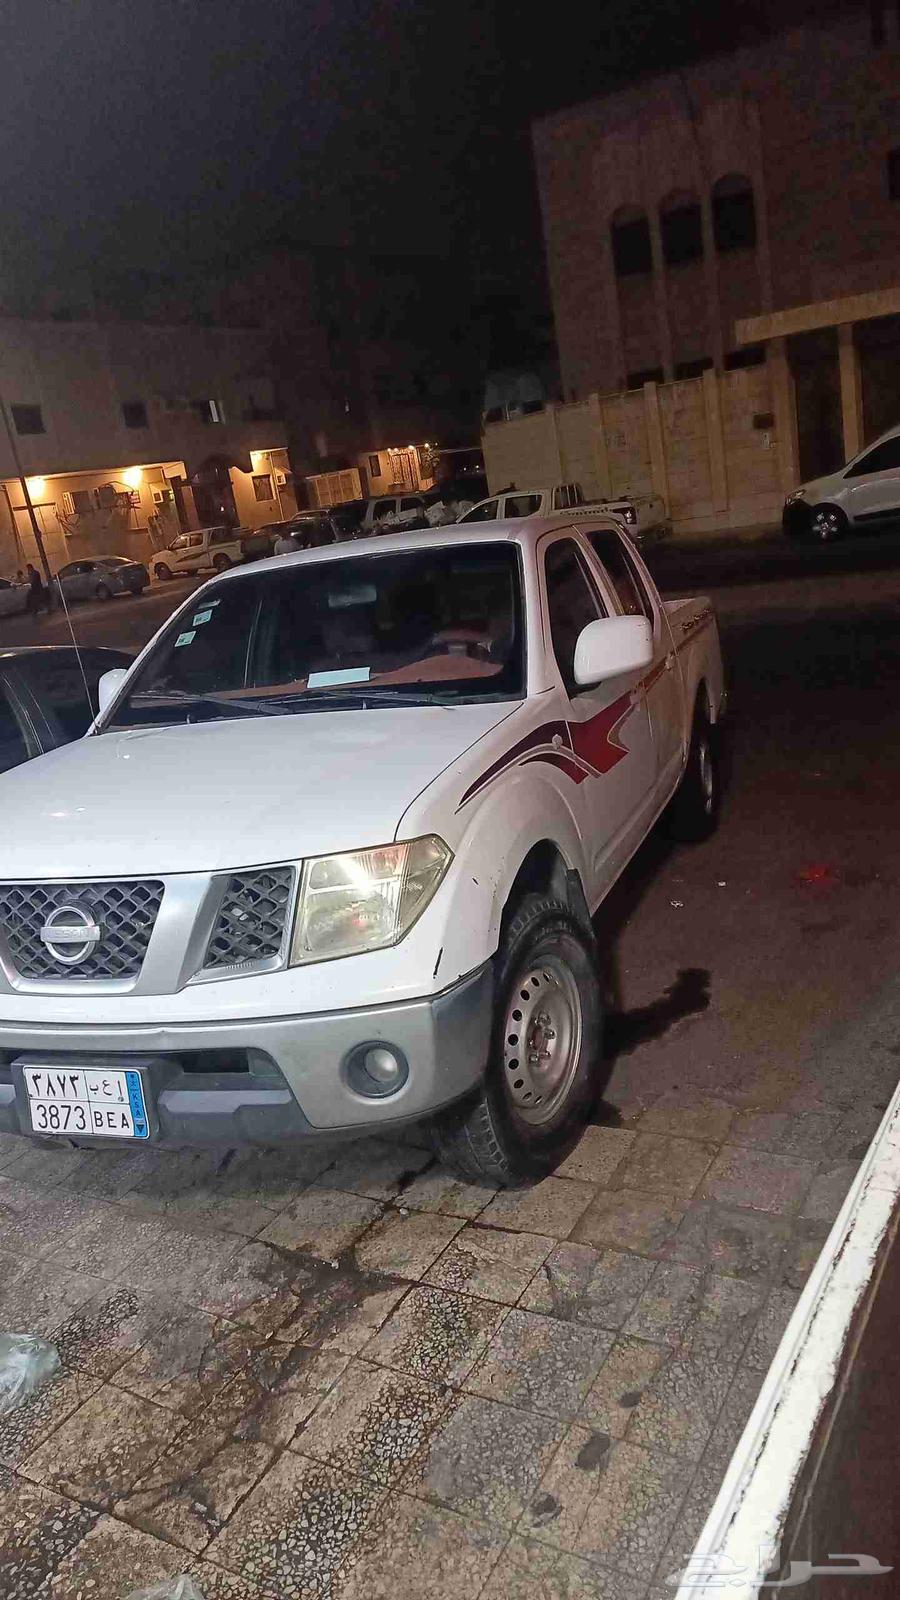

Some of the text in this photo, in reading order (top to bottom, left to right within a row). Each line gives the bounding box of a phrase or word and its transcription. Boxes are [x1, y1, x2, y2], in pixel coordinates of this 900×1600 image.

[32, 1073, 79, 1098] ٣٨٧٣
[36, 1104, 130, 1131] 3873 BEA
